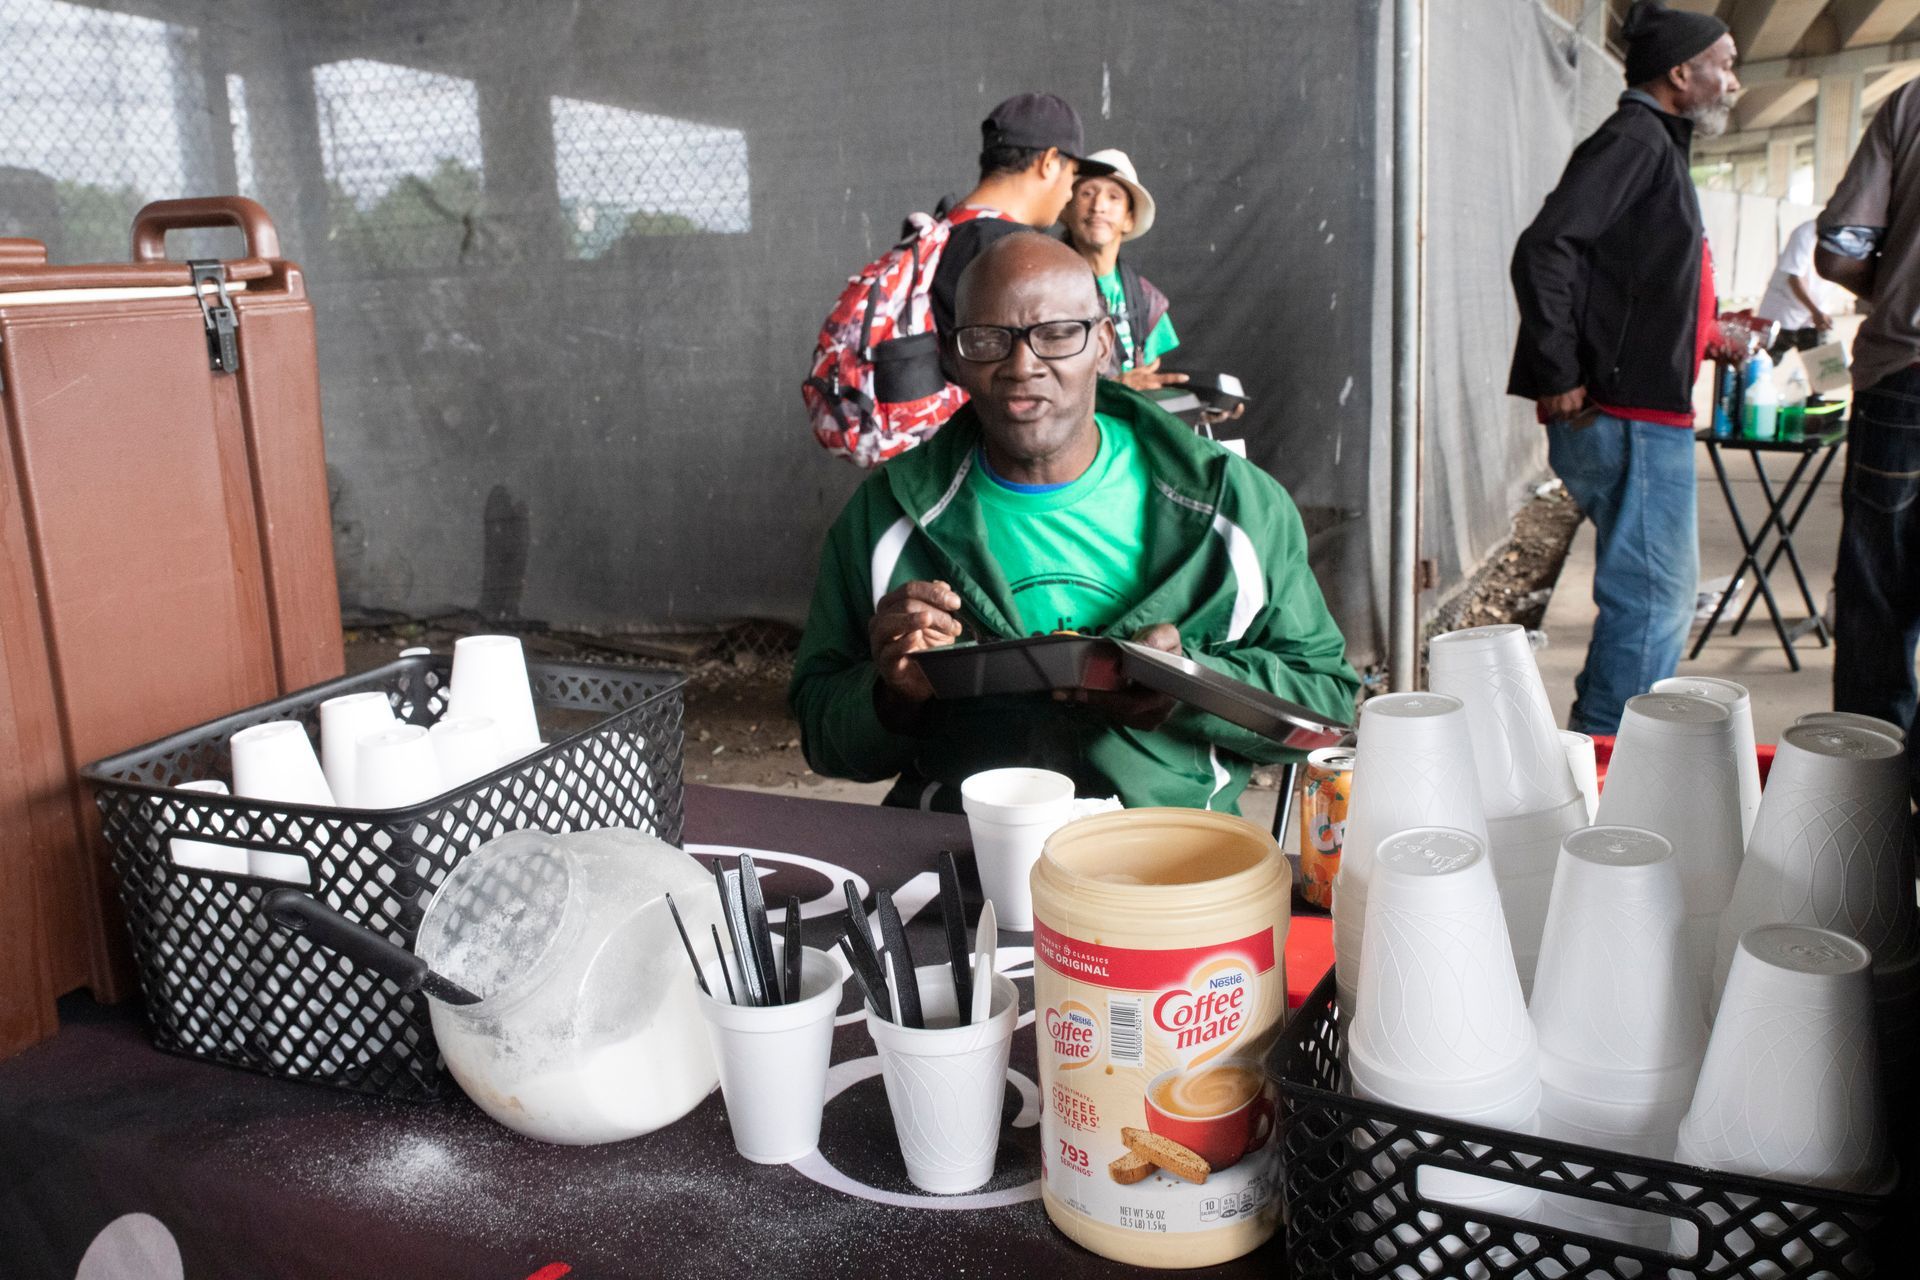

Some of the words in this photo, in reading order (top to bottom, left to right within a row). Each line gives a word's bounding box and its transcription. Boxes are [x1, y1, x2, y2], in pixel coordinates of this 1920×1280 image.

[1041, 942, 1055, 959] THE
[1056, 953, 1110, 977] ORIGINAL
[1073, 951, 1109, 965] CLASSICS
[1153, 986, 1244, 1032] Coffee
[1045, 1007, 1093, 1042] Coffee
[1176, 1012, 1240, 1049] mate
[1054, 1040, 1090, 1058] mate
[1052, 1086, 1096, 1116] COFFEE
[1063, 1115, 1082, 1131] SIZE
[1059, 1138, 1089, 1167] 793
[1120, 1205, 1132, 1216] NET
[1133, 1207, 1144, 1218] WT
[1145, 1209, 1155, 1219] 56
[1156, 1210, 1165, 1220] OZ
[1205, 1200, 1215, 1211] 10
[1120, 1216, 1133, 1228] (3.5
[1134, 1218, 1146, 1230] LB)
